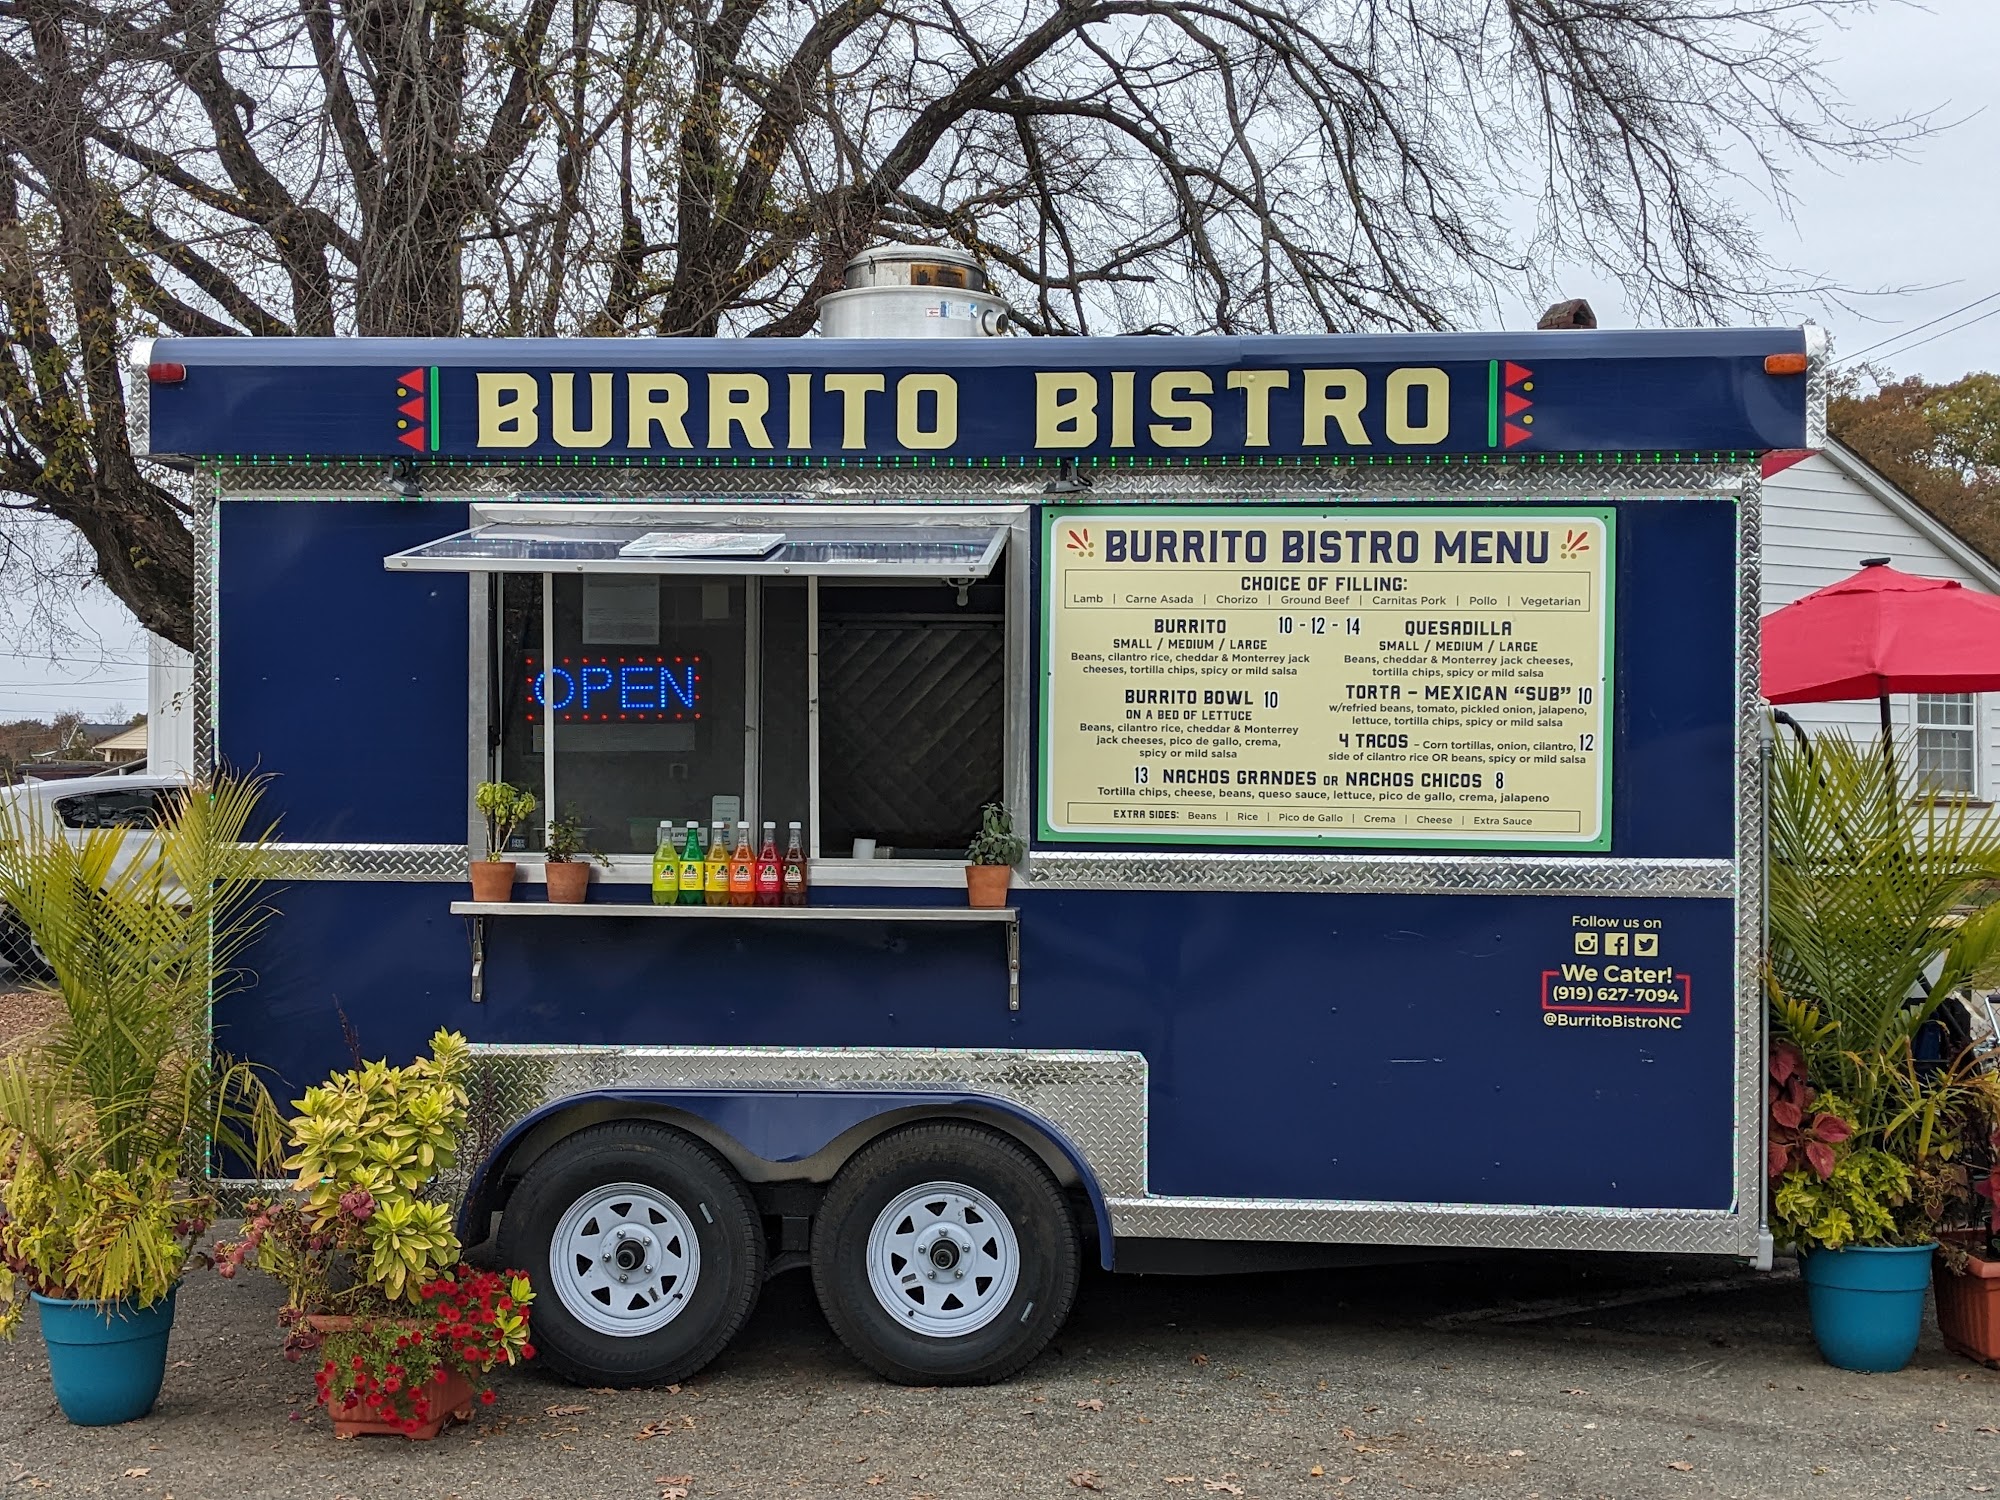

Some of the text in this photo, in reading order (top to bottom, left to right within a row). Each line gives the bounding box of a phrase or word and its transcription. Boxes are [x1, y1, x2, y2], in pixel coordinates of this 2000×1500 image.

[476, 368, 1449, 449] BURRITO BISTRO
[1105, 530, 1549, 564] BURRITO BISTRO MENU
[1241, 576, 1407, 591] CHOICE OF FILLING:
[1074, 594, 1581, 607] Lamb Carne Asada Chorizo Ground Beef Carnitas Pork Pollo Vegetarian
[1154, 619, 1226, 634] BURRITO
[1279, 616, 1360, 635] 10 12 14
[1405, 621, 1511, 636] QUESADILLA
[1113, 639, 1267, 650] SMALL MEDIUM LARGE
[1379, 641, 1538, 652] SMALL MEDIUM LARGE
[1071, 652, 1310, 664] Beans, cilantro rice, cheddar & Monterrey jack
[1344, 655, 1573, 667] Beans, cheddar & Monterrey jack cheeses,
[1083, 665, 1127, 675] cheeses,
[1130, 665, 1164, 674] tortilla
[1167, 665, 1198, 675] chips,
[1201, 666, 1228, 675] spicy
[1245, 666, 1268, 675] mild
[1272, 666, 1297, 675] salsa
[1372, 667, 1408, 676] tortilla
[1412, 668, 1444, 677] chips,
[1447, 668, 1474, 678] spicy
[1491, 668, 1515, 677] mild
[1518, 669, 1544, 677] salsa
[533, 665, 695, 711] OPEN
[1345, 685, 1400, 700] TORTA
[1425, 685, 1507, 701] MEXICAN
[1578, 687, 1592, 705] 10
[1125, 689, 1278, 708] BURRITO BOWL 10
[1126, 709, 1252, 721] ON A BED OF LETTUCE
[1329, 703, 1587, 716] w/refried beans, tomato, pickled onion, jalapeno,
[1352, 716, 1391, 726] lettuce,
[1394, 716, 1429, 725] tortilla
[1432, 717, 1462, 727] chips,
[1465, 717, 1493, 727] spicy
[1510, 718, 1534, 726] mild
[1537, 718, 1563, 727] salsa
[1080, 723, 1299, 736] Beans, cilantro rice, cheddar & Monterrey
[1096, 735, 1281, 748] jack cheeses, pico de gallo, crema,
[1339, 733, 1594, 752] 4 TACOS Corn tortillas, onion, cilantro, 12
[1139, 748, 1167, 759] spicy
[1185, 749, 1208, 758] mild
[1211, 749, 1237, 758] salsa
[1328, 752, 1350, 761] side
[1353, 752, 1364, 761] of
[1366, 752, 1406, 761] cilantro
[1409, 753, 1429, 762] rice
[1432, 753, 1448, 762] OR
[1451, 753, 1486, 763] beans,
[1488, 754, 1516, 764] spicy
[1534, 754, 1557, 763] mild
[1560, 755, 1586, 764] salsa
[1135, 766, 1503, 789] 13 NACHOS GRANDES OR NACHOS CHICOS 8
[1097, 787, 1550, 804] Tortilla chips, cheese, beans, queso sauce, lettuce, pico de gallo, crema, jalapeno
[1114, 810, 1532, 825] EXTRA SIDES: Beans Rice Pico de Gallo Crema Cheese Extra Sauce
[1572, 915, 1662, 929] Follow us on
[1561, 964, 1672, 984] We Cater!
[1553, 986, 1679, 1002] (919) 627-7094
[1543, 1012, 1682, 1029] @BurritoBistroNC
